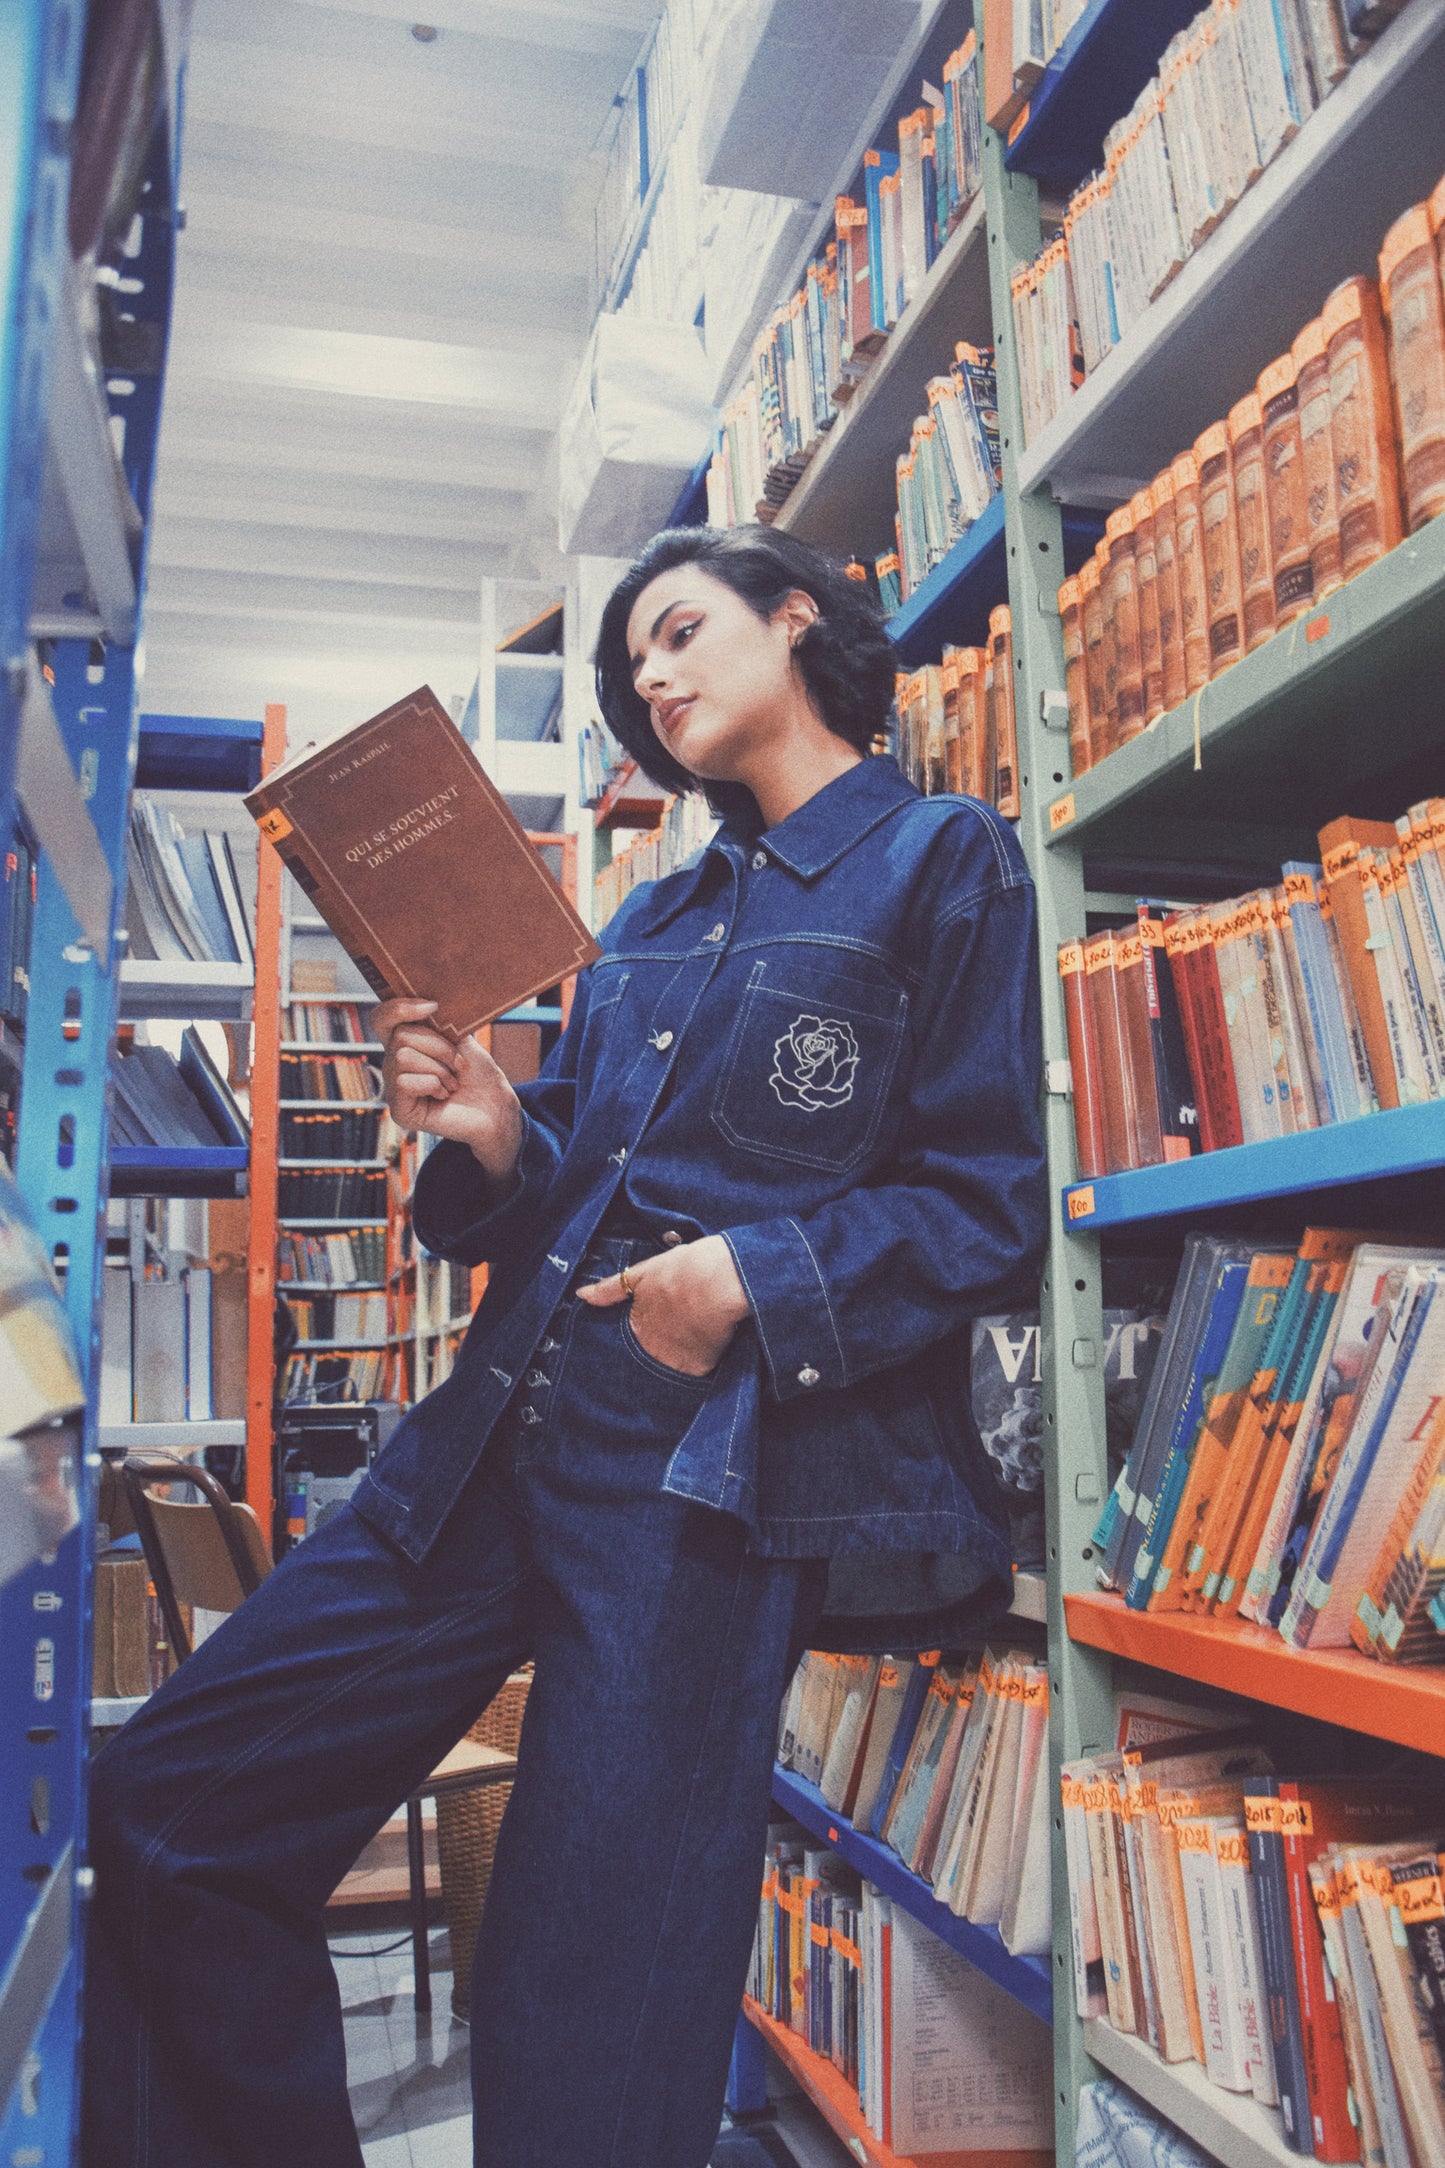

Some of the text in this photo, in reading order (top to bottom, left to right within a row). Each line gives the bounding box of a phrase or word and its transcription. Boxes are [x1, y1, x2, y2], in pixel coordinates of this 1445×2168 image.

[351, 742, 392, 769] RASPAIL
[345, 784, 460, 862] QUI SE SOUVIENT
[366, 846, 393, 869] DES
[1140, 924, 1157, 939] 33
[1199, 1887, 1209, 1938] Testament
[1231, 1887, 1264, 2067] La Bible Nouveau Testament
[1206, 1983, 1222, 2026] Bible
[1212, 2029, 1224, 2052] La
